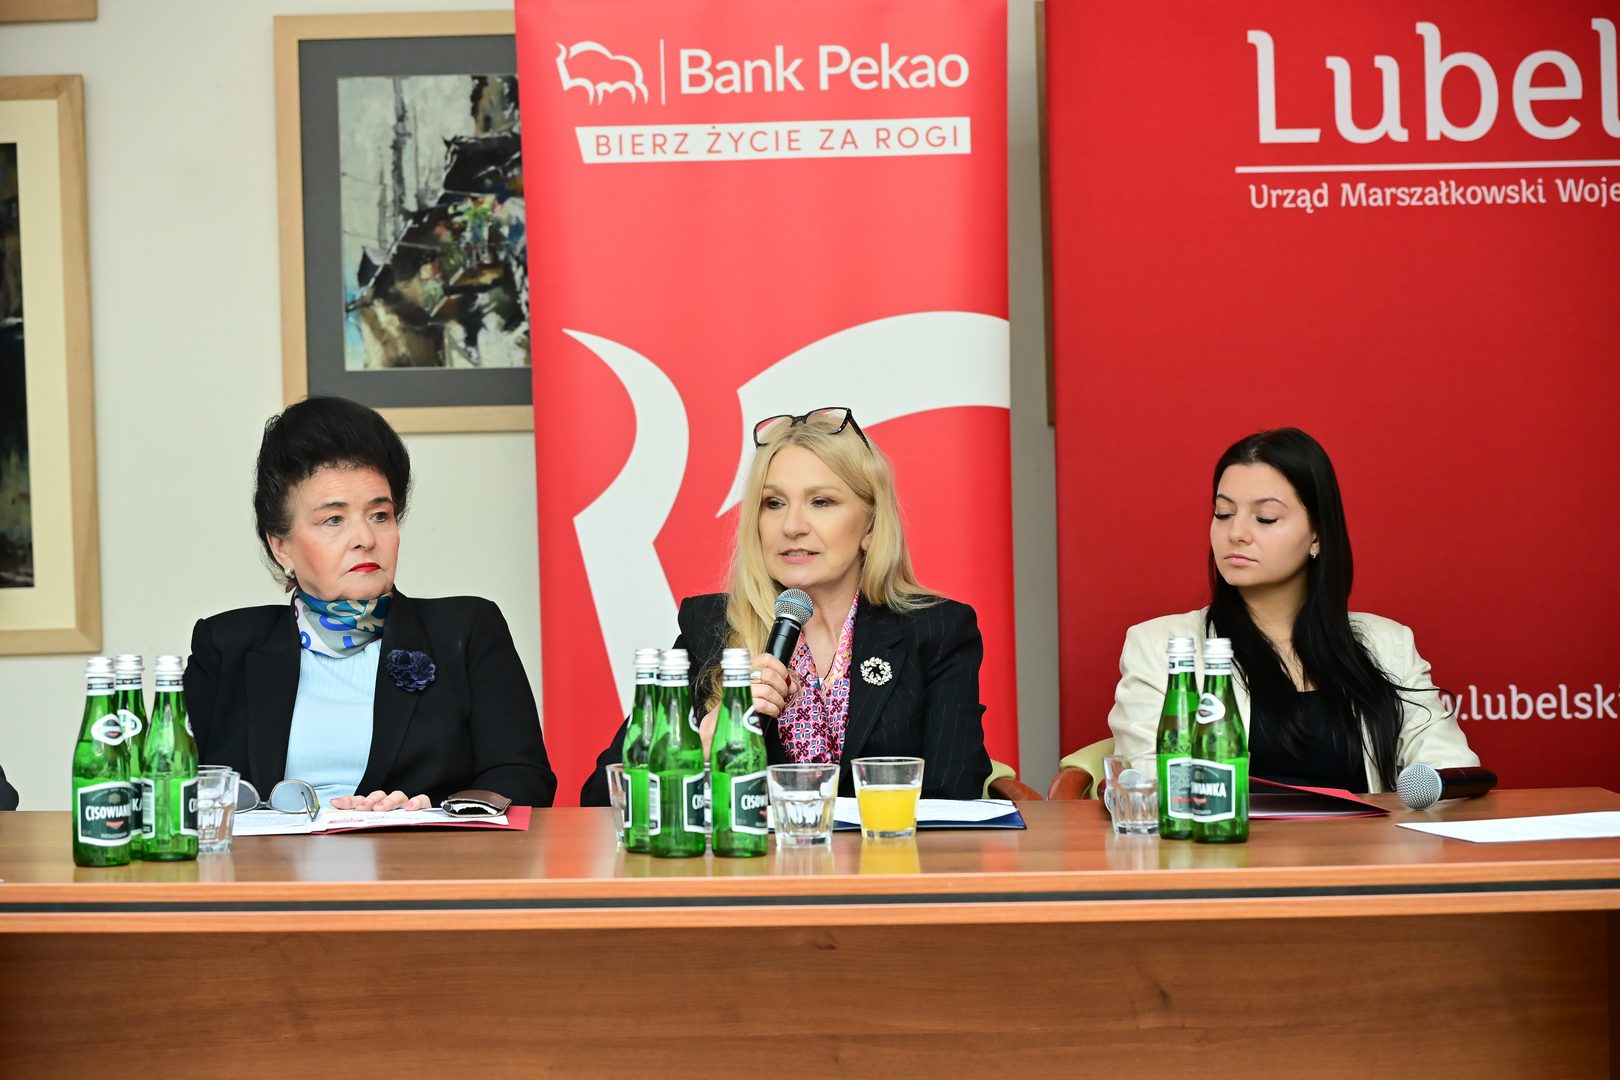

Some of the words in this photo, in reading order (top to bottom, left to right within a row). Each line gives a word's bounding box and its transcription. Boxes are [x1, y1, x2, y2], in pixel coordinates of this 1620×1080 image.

[679, 45, 805, 95] Bank
[818, 42, 970, 91] Pekao
[1247, 18, 1620, 144] Lubel
[595, 132, 689, 156] BIERZ
[706, 125, 802, 153] ŻYCIE
[819, 128, 859, 150] ZA
[875, 125, 957, 149] ROGI
[1249, 182, 1329, 214] Urząd
[1340, 178, 1547, 207] Marszałkowski
[1440, 683, 1620, 721] w.lubelsk
